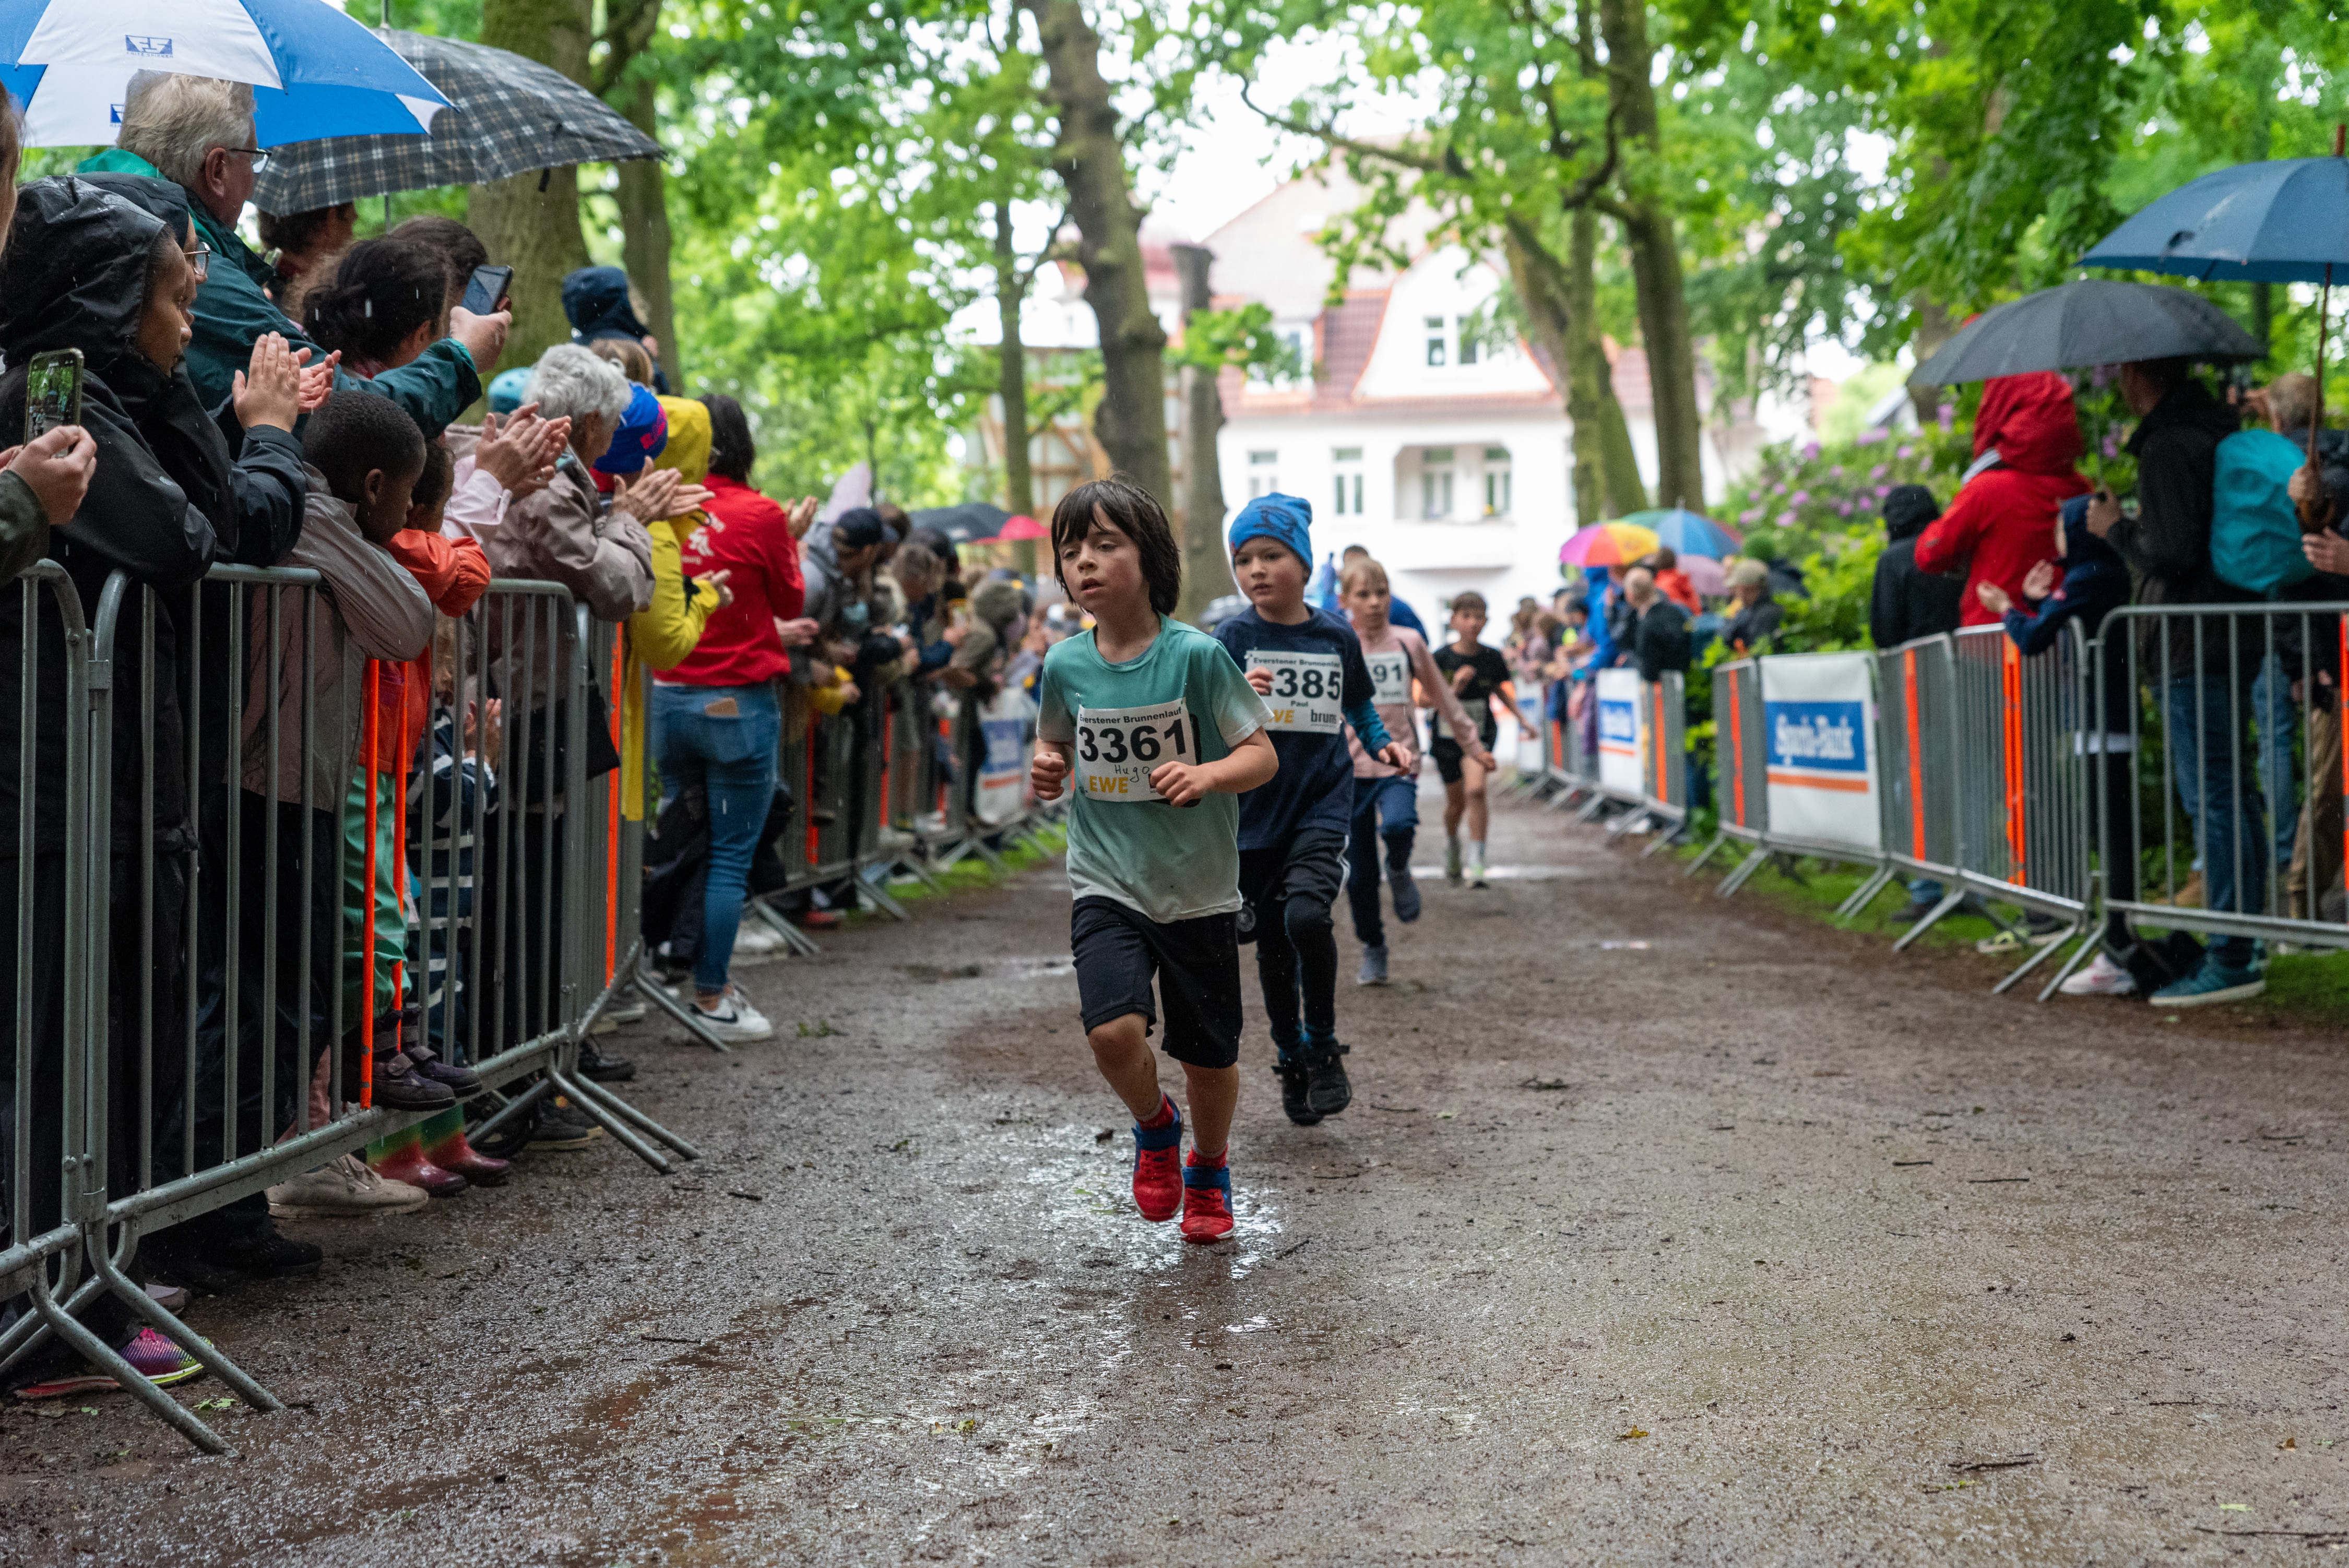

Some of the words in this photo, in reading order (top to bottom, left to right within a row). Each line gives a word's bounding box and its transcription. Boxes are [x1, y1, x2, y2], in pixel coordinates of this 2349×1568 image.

[1272, 668, 1341, 700] 385
[1123, 706, 1182, 723] Brunnenlauf
[1268, 709, 1295, 724] WE
[1078, 718, 1187, 763] 3361
[1114, 764, 1150, 782] Hugo
[1089, 775, 1129, 793] EWE
